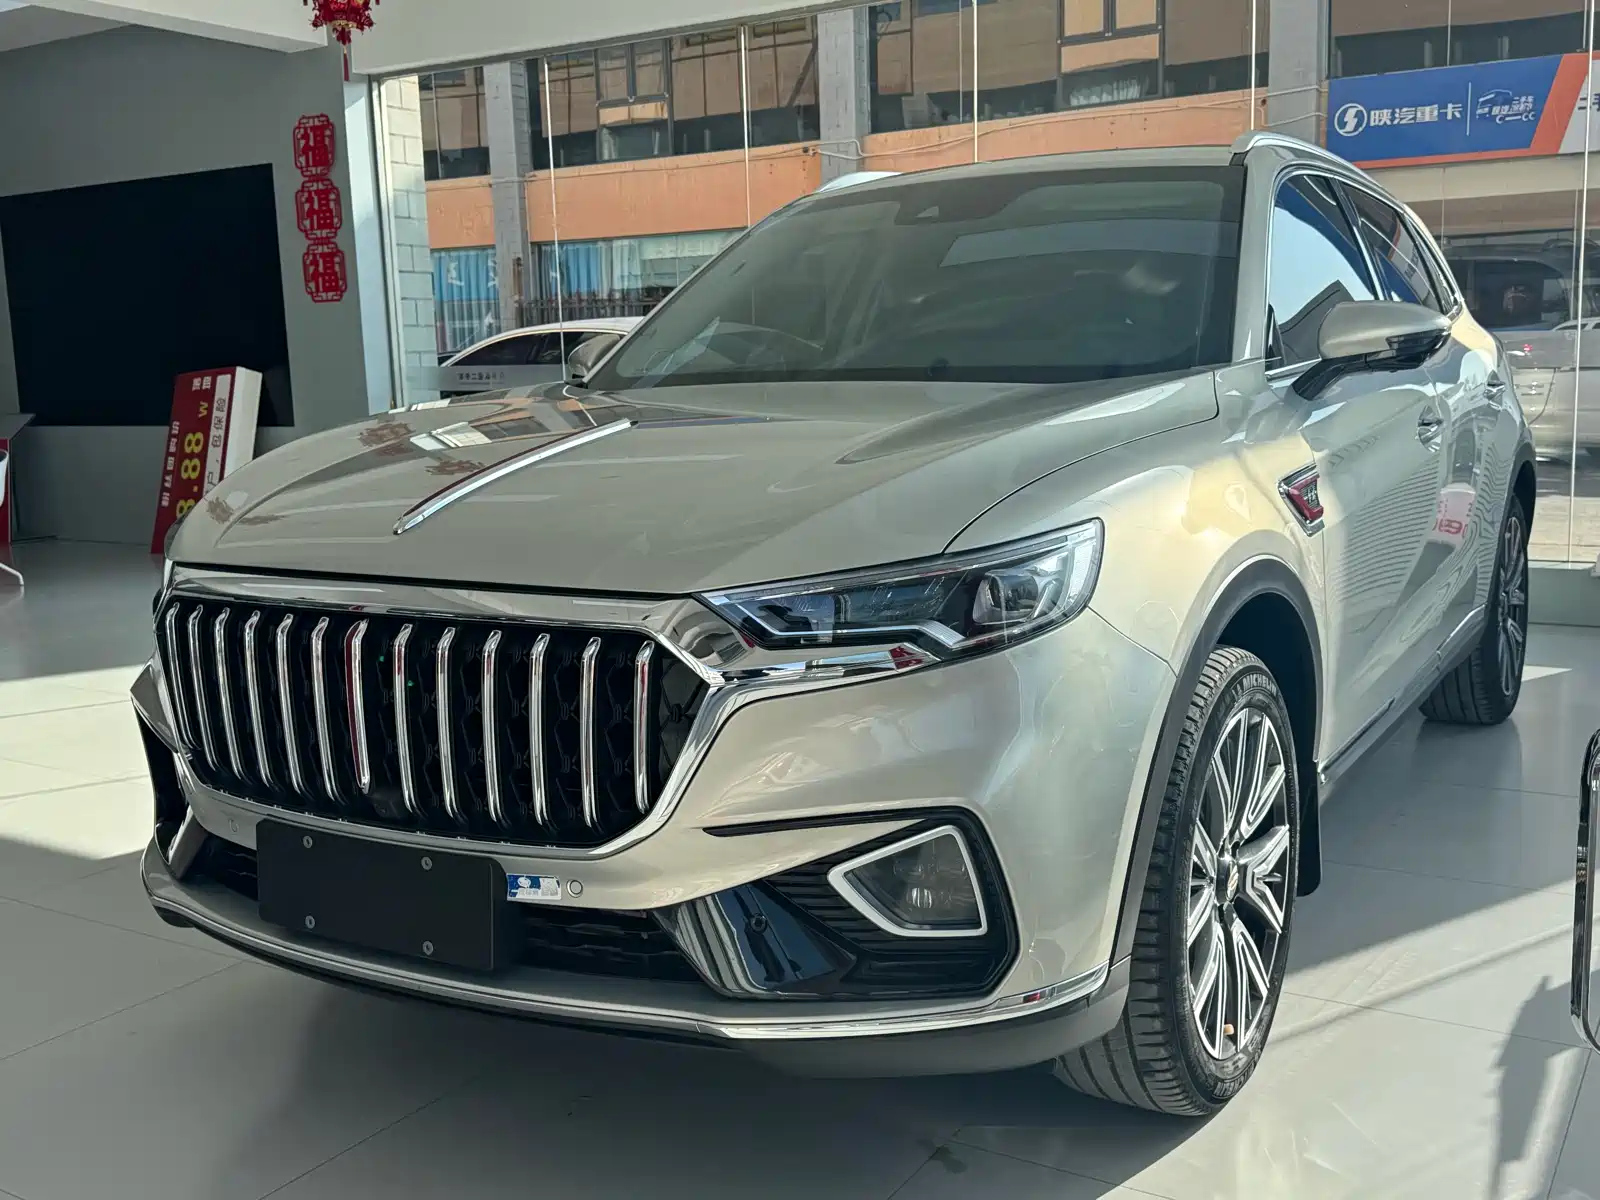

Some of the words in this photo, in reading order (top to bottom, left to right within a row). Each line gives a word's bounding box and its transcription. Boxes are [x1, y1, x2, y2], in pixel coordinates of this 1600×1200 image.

[1369, 103, 1463, 127] 陕汽重卡
[1242, 673, 1277, 697] MICHELIN
